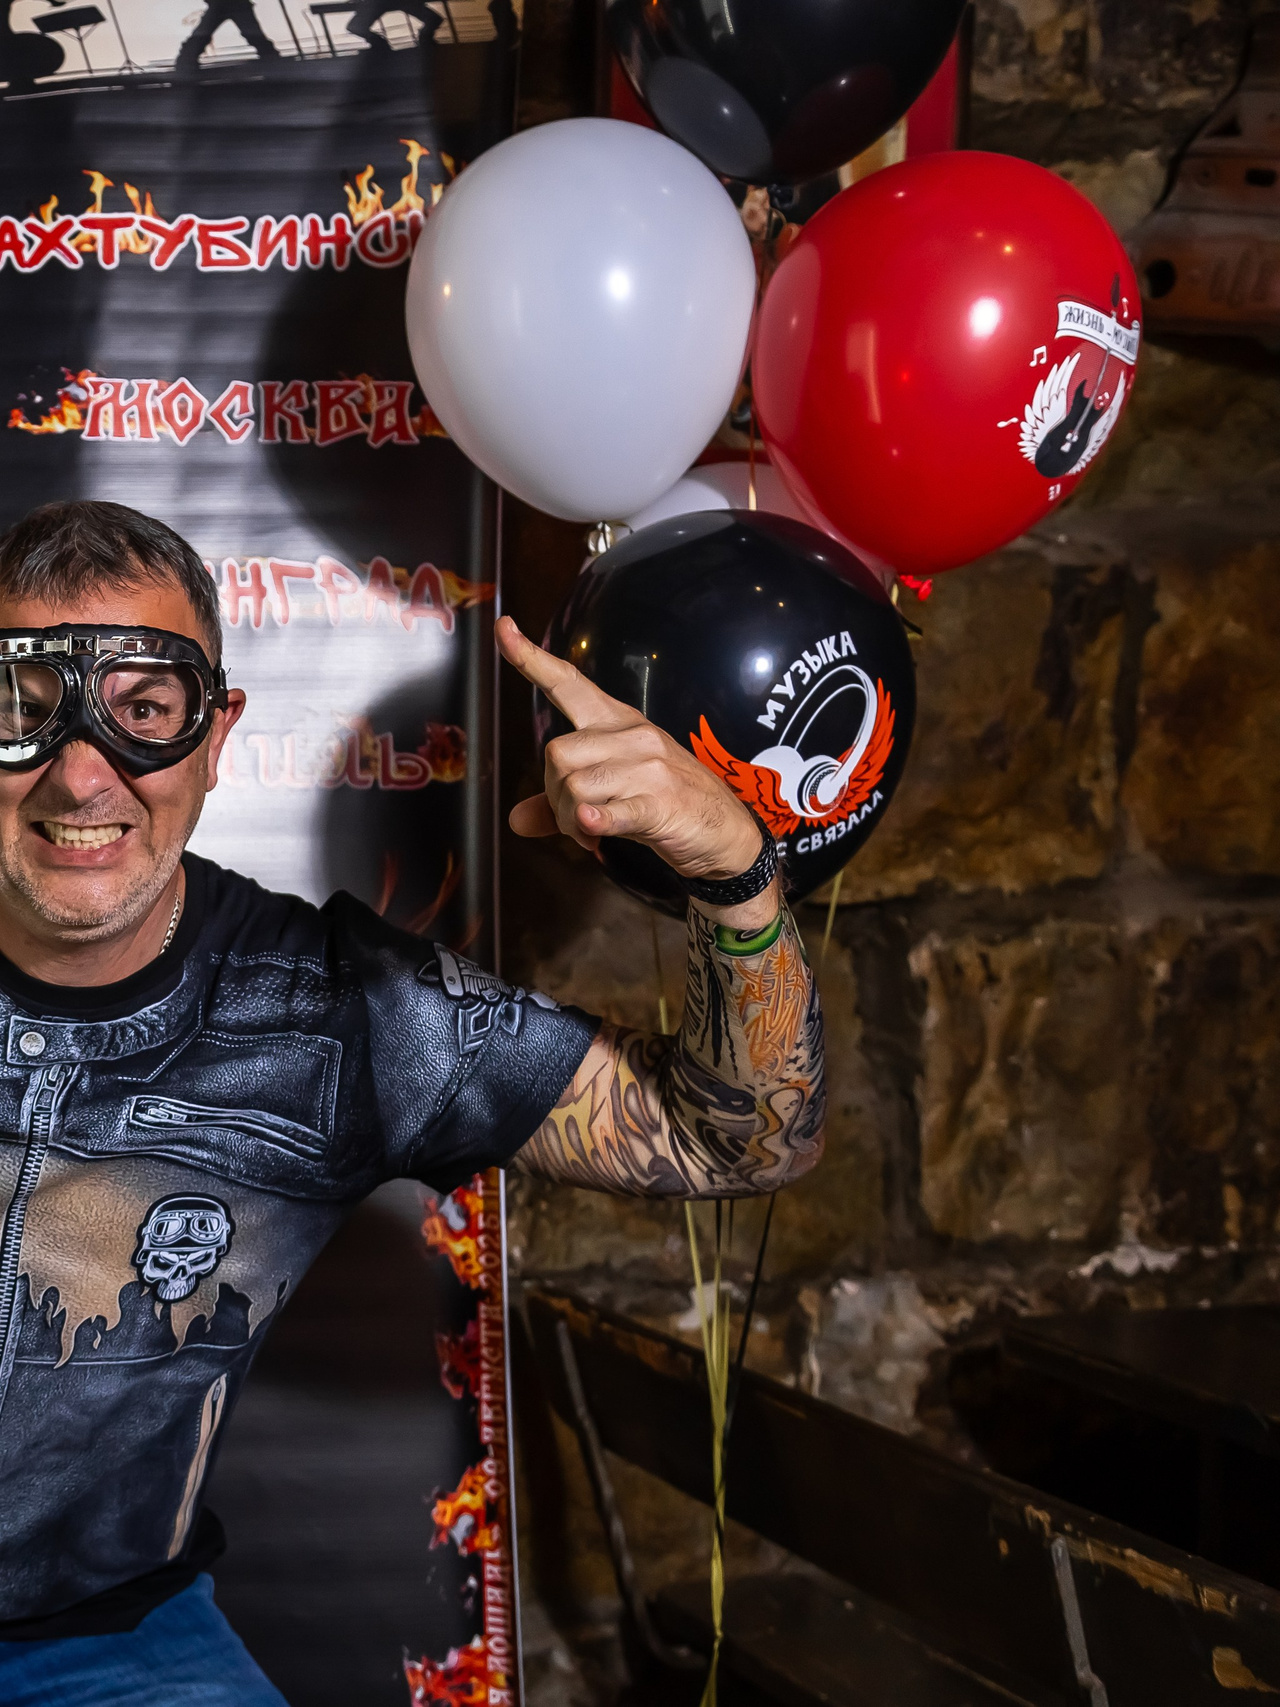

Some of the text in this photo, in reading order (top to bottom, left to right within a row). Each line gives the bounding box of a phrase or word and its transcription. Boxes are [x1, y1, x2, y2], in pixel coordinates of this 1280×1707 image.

[1063, 304, 1105, 335] ЖИЗНЬ
[81, 377, 419, 447] МОСКВА
[205, 556, 455, 634] НГРАД
[756, 630, 858, 731] МУЗЫКА
[796, 790, 884, 853] СВЯЗАЛА
[477, 1212, 502, 1288] 2025
